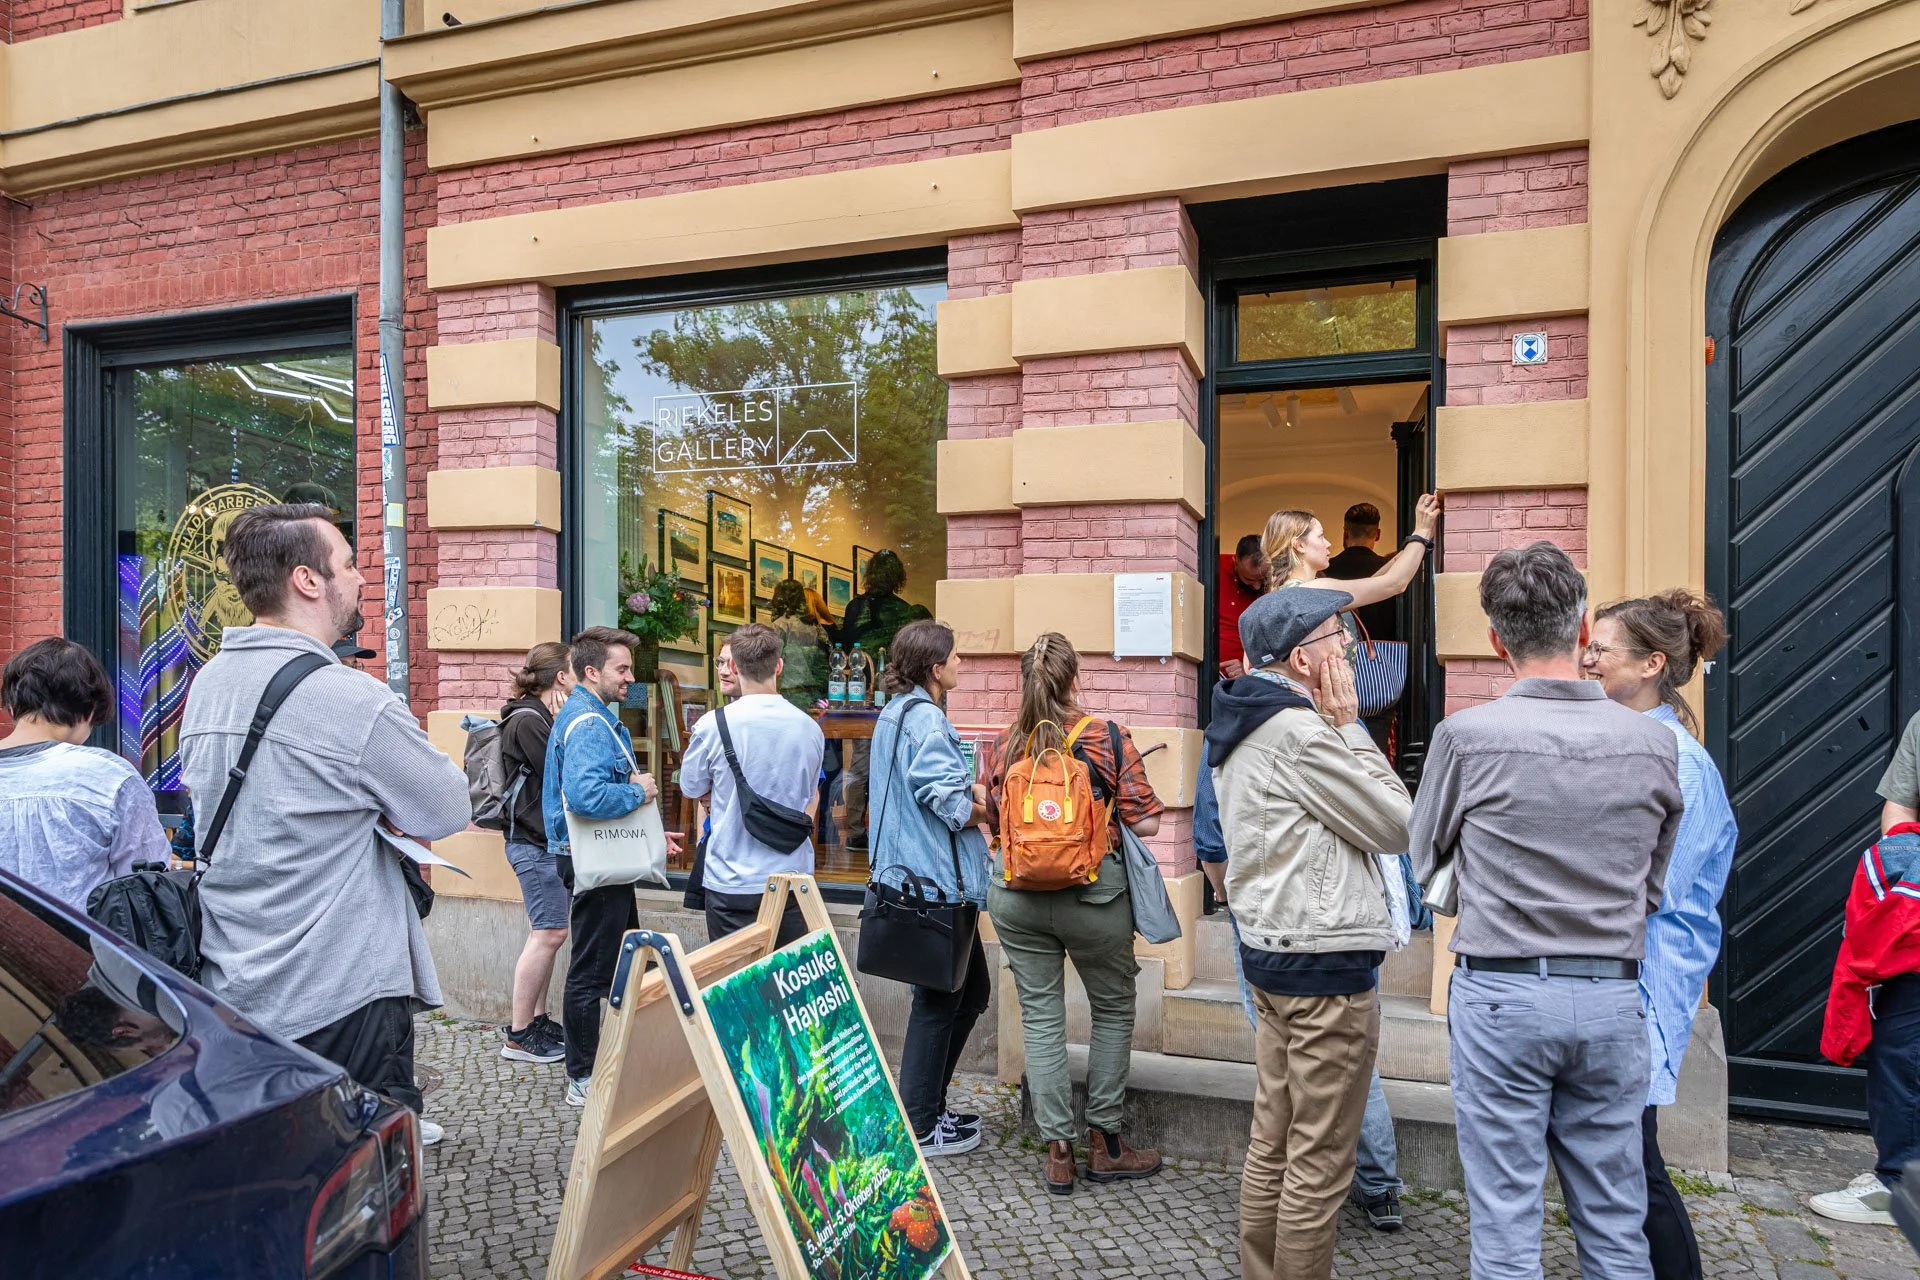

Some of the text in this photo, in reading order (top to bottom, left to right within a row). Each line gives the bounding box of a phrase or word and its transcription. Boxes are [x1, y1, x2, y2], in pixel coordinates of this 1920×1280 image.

[658, 400, 773, 428] RIEKELES
[657, 435, 774, 463] GALLERY
[594, 828, 648, 840] RIMOWA
[772, 950, 837, 999] Kosuke
[782, 975, 850, 1037] Hayashi
[852, 1022, 860, 1031] aus
[797, 1074, 806, 1084] den
[821, 1071, 829, 1082] Der
[828, 1078, 837, 1090] this
[860, 1051, 872, 1065] World
[857, 1072, 880, 1095] Deutschland
[806, 1239, 818, 1255] 5.
[816, 1220, 834, 1247] Juni
[836, 1210, 847, 1225] 5.
[844, 1184, 873, 1217] Oktober
[872, 1165, 891, 1189] 2025
[813, 1258, 823, 1270] Do.
[833, 1238, 841, 1247] 12
[847, 1221, 856, 1234] Uhr
